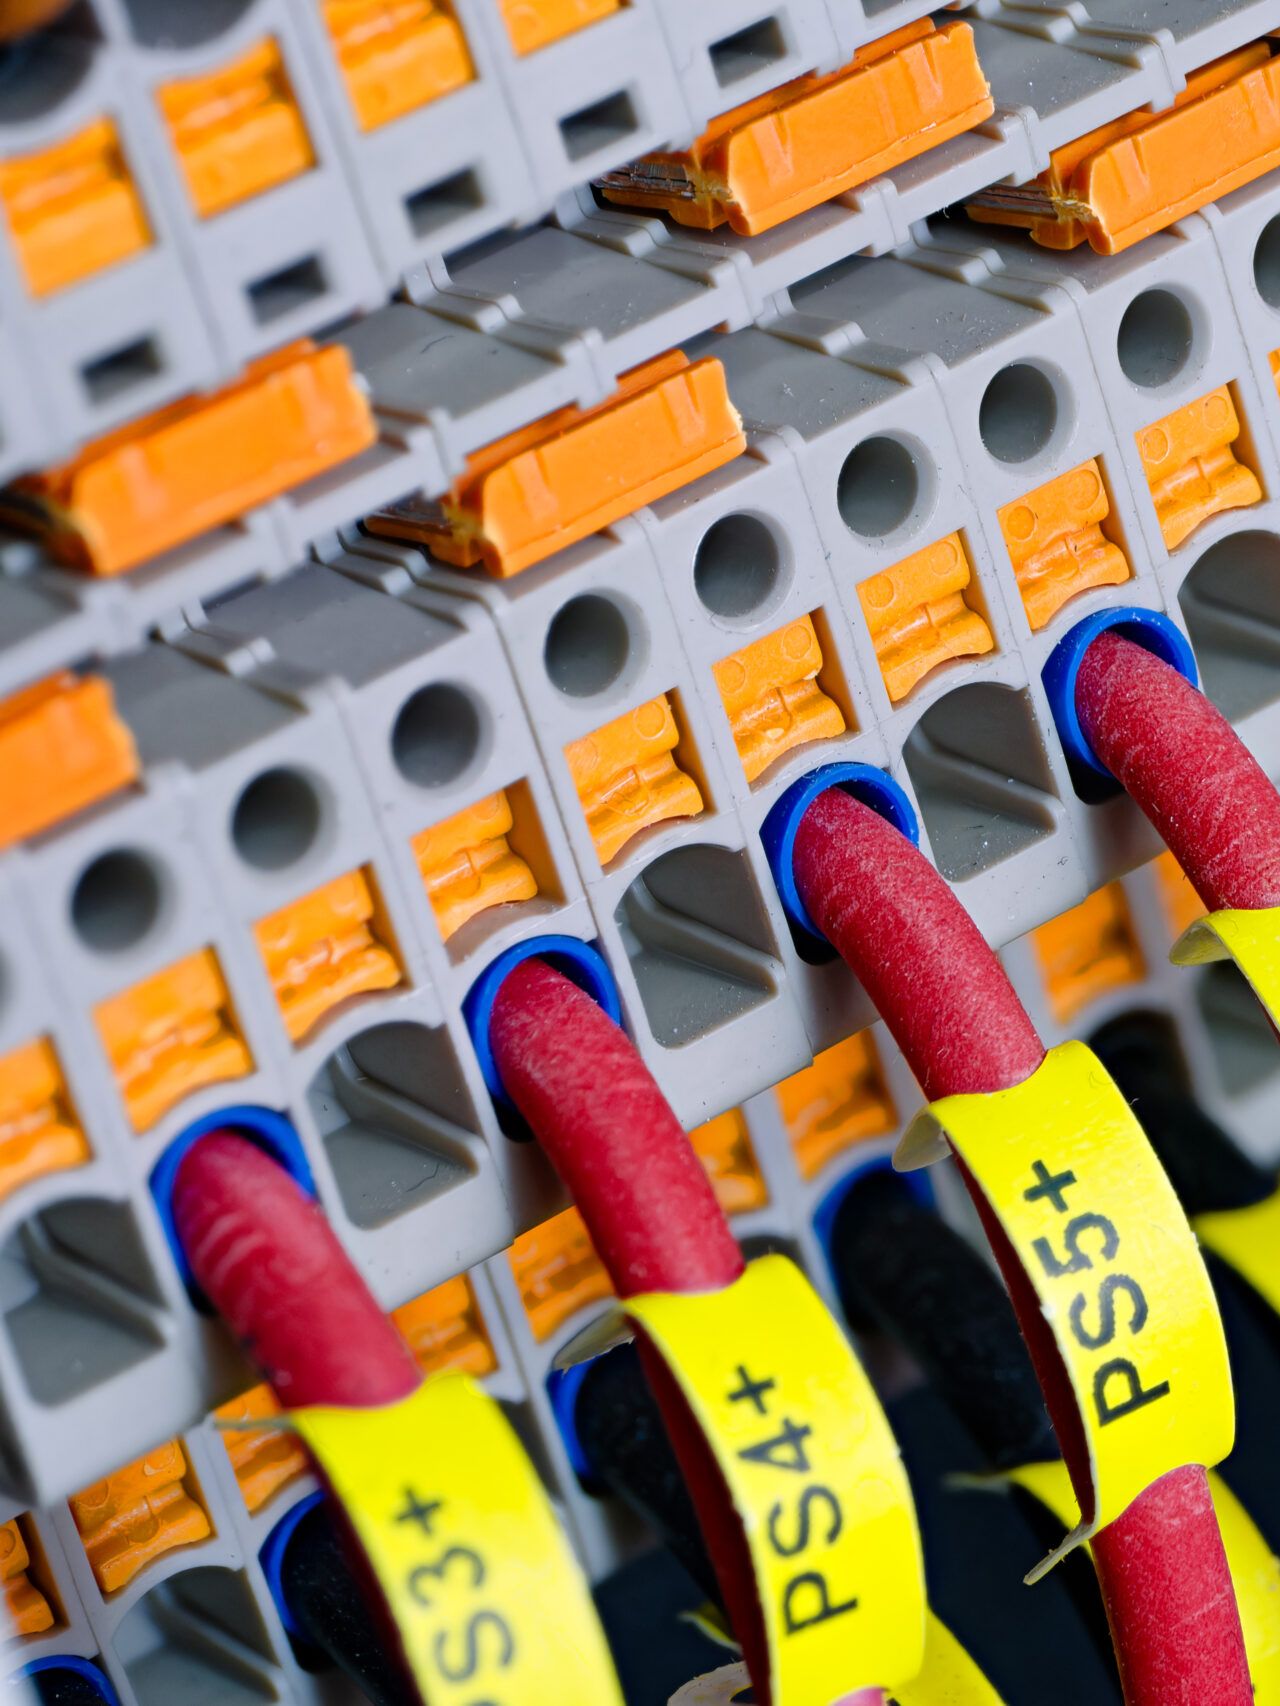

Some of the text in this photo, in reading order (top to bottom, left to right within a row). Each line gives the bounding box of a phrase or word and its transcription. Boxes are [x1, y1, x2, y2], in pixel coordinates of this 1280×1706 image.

[1023, 1158, 1171, 1427] PS5+
[394, 1486, 516, 1706] S3+
[726, 1364, 859, 1637] PS4+
